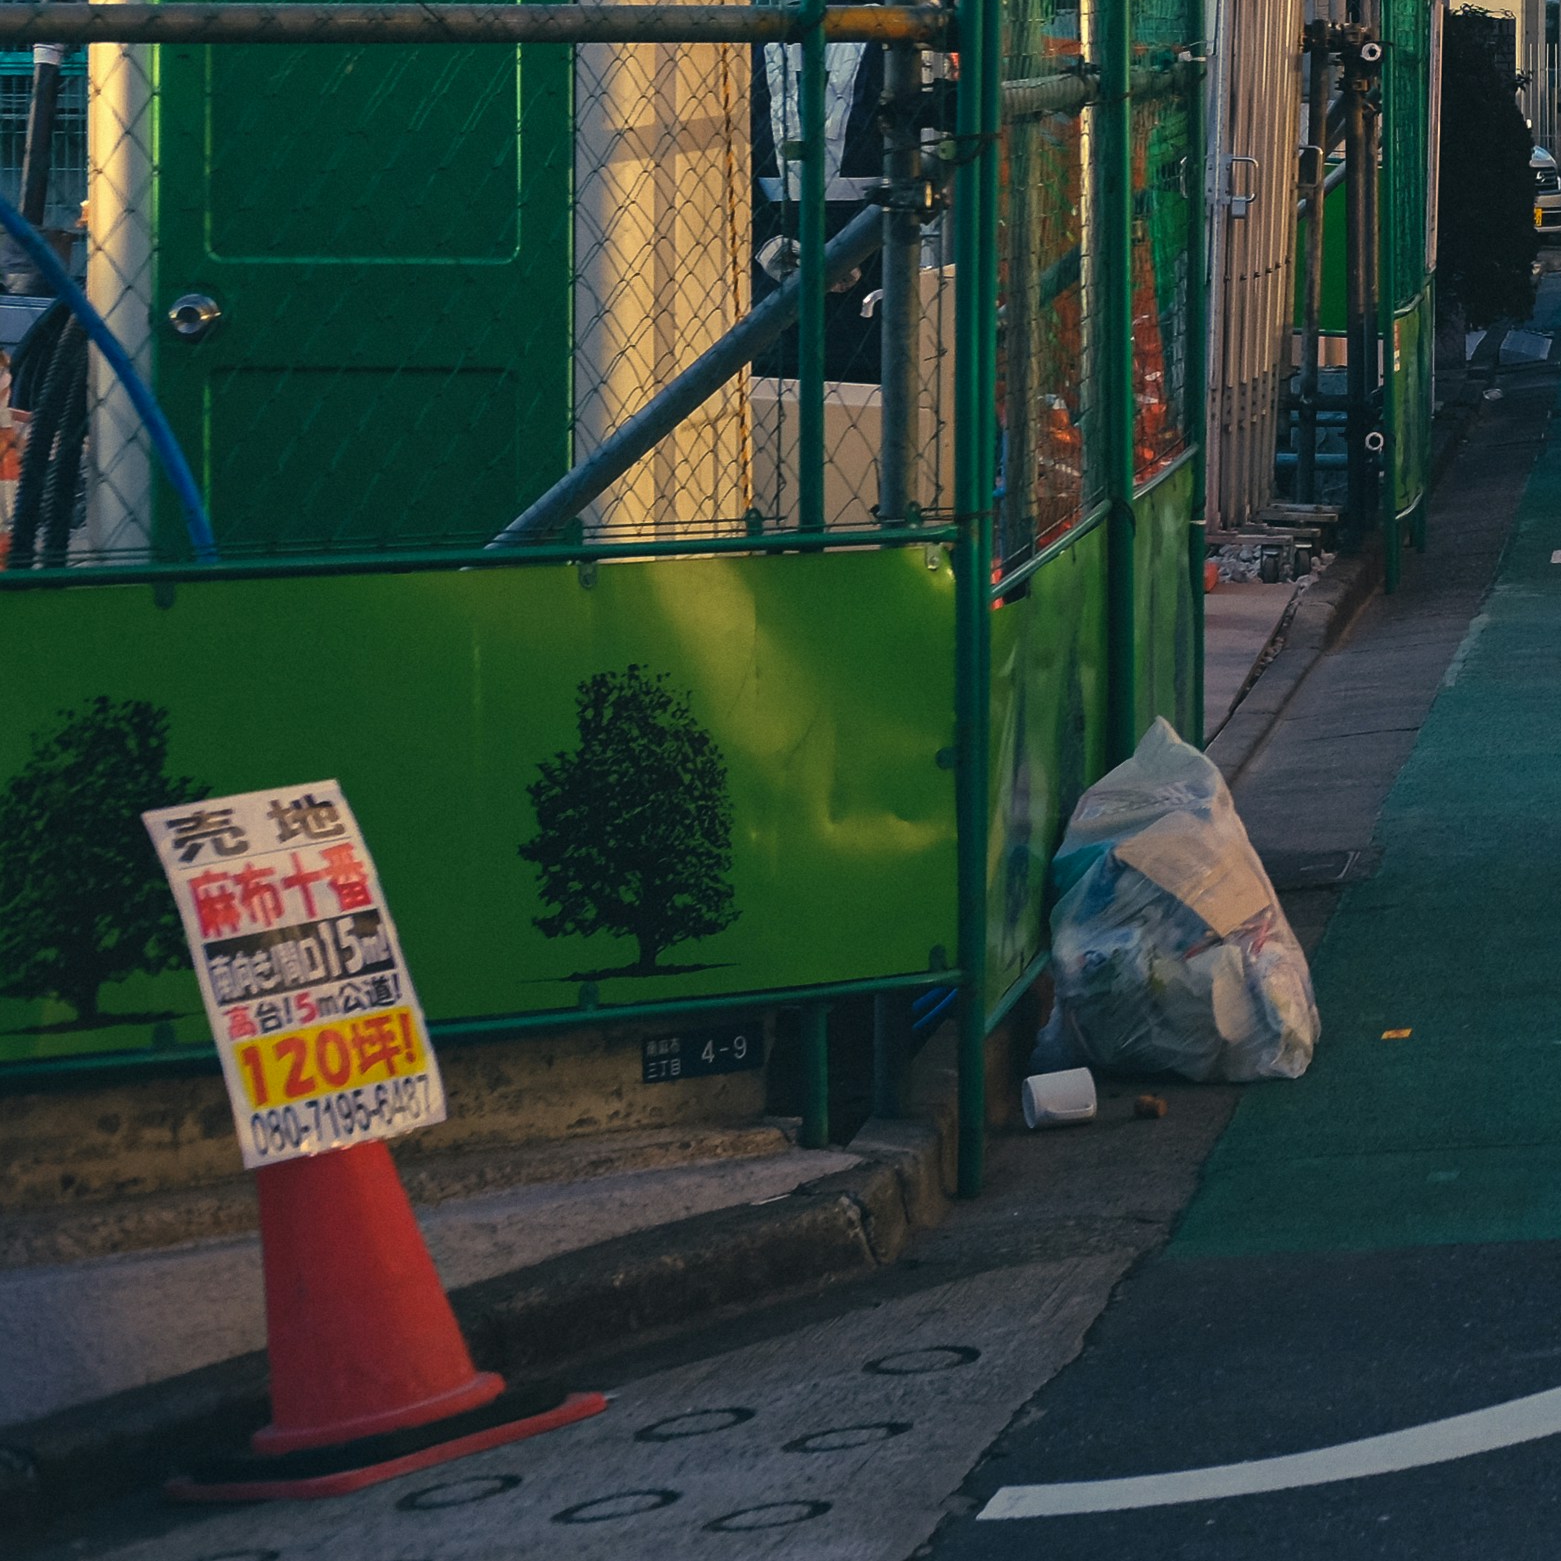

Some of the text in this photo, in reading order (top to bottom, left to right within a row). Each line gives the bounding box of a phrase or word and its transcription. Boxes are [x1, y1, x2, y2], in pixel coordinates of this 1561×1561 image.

[188, 842, 372, 938] 麻布十番
[241, 1011, 418, 1108] 120坪!
[647, 1058, 681, 1079] 三丁目
[701, 1035, 748, 1064] 4-9
